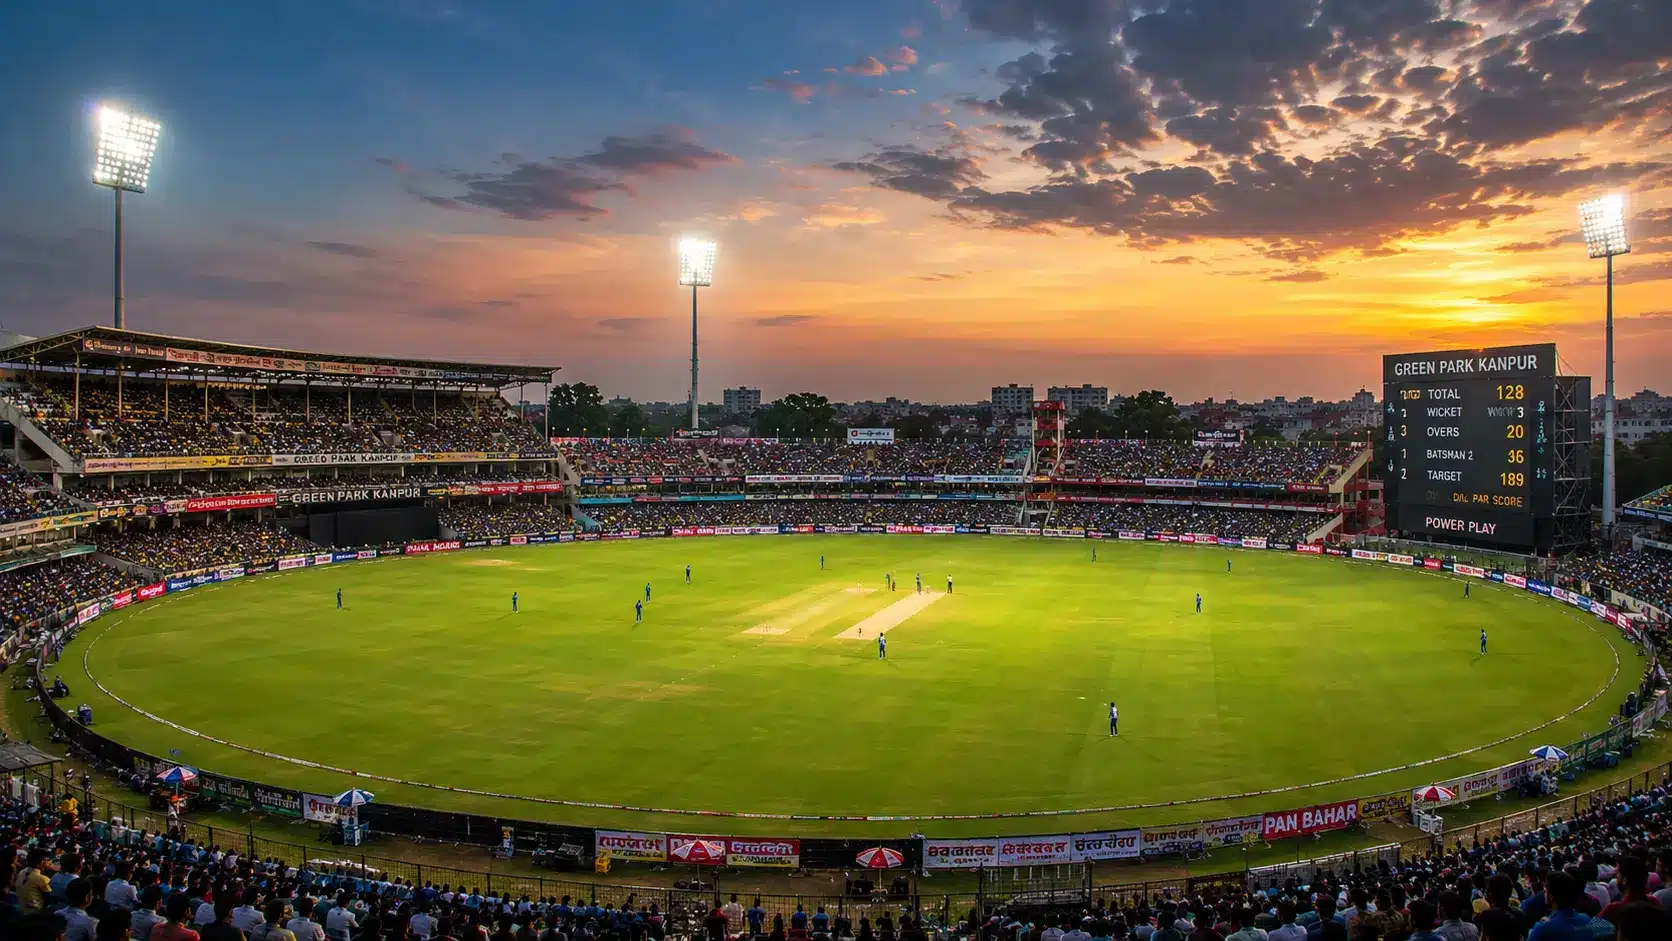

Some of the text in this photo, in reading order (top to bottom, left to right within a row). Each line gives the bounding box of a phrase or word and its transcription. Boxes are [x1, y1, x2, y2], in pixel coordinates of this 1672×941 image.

[1395, 355, 1537, 376] GREEN PARK KANPUR
[1428, 388, 1461, 399] TOTAL
[1496, 385, 1524, 400] 128
[1427, 406, 1462, 417] WICKET
[1517, 407, 1524, 418] 3
[1400, 425, 1524, 439] 3 OVERS 20
[1401, 448, 1407, 459] 1
[1468, 451, 1473, 460] 2
[1401, 468, 1524, 487] 2 TARGET 189
[337, 490, 369, 501] PARK
[373, 488, 420, 499] KANPUR
[1473, 494, 1489, 504] PAR
[1493, 495, 1523, 507] SCORE
[1426, 517, 1496, 535] POWER PLAY
[1264, 813, 1298, 834] PAN
[1302, 803, 1357, 829] BAHAR
